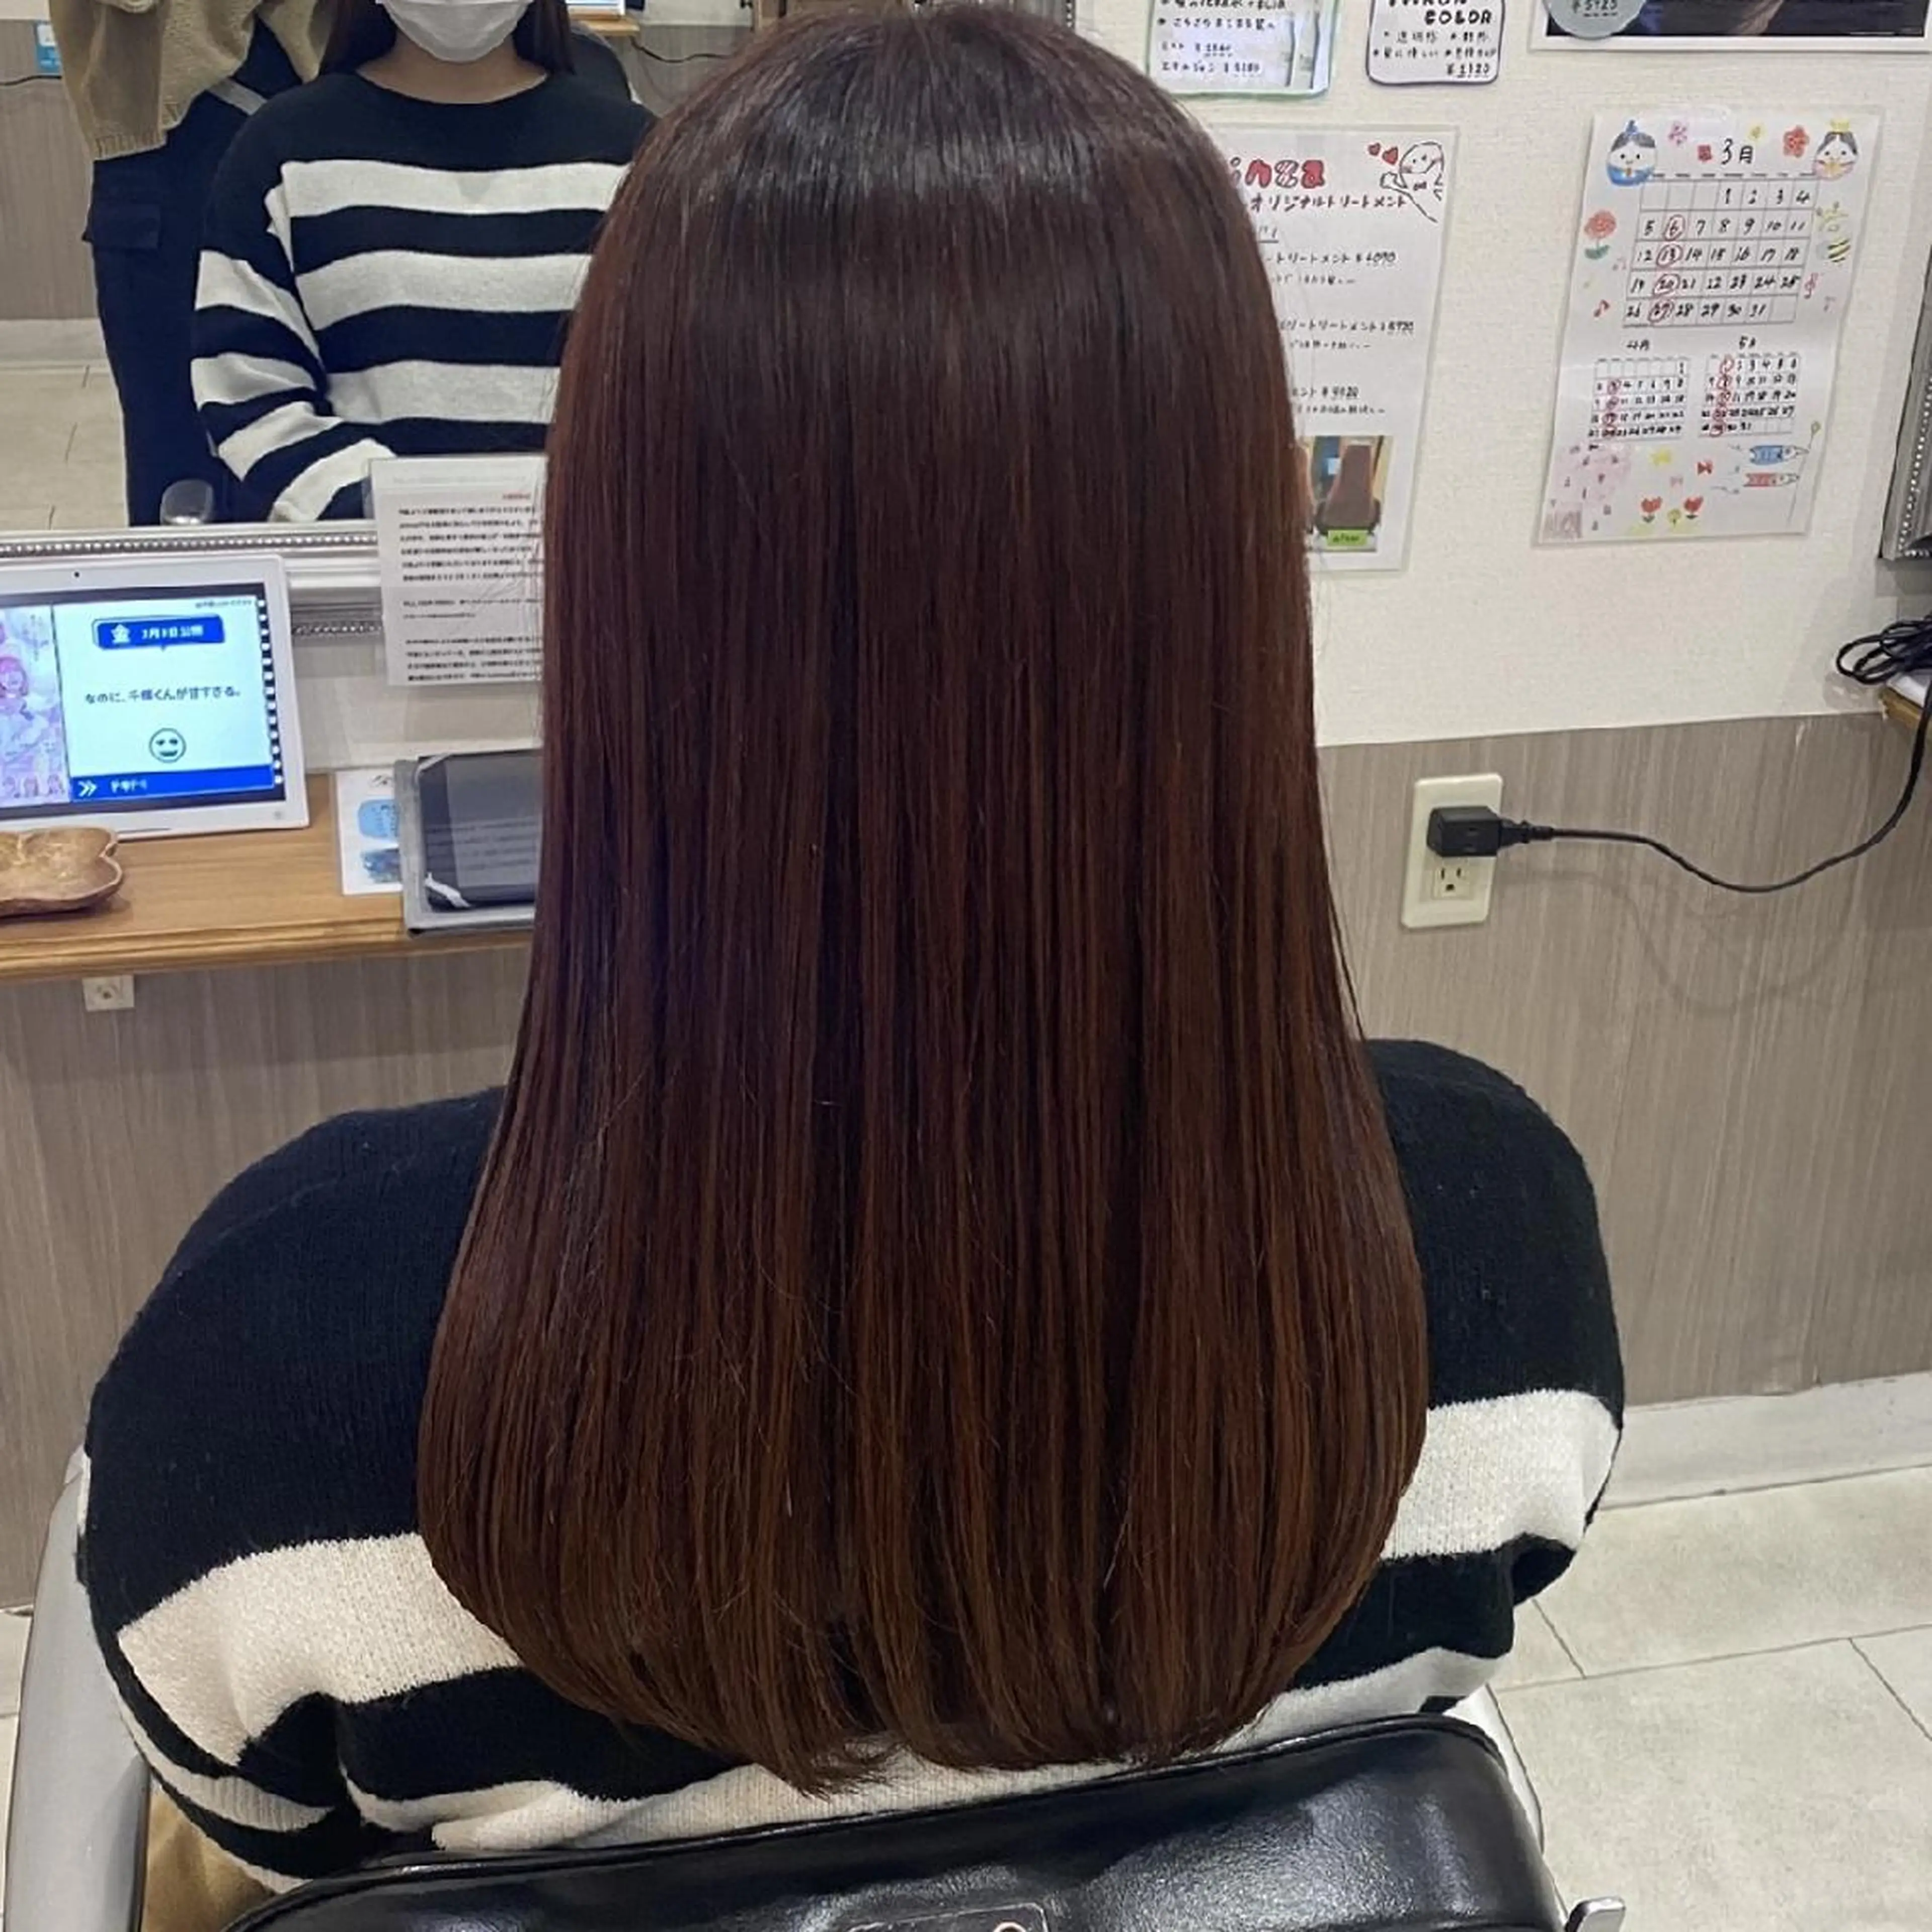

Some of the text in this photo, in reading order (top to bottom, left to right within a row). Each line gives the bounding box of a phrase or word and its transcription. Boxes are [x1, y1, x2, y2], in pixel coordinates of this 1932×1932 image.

[1425, 10, 1491, 25] COLOR
[1721, 138, 1753, 165] 3月
[1251, 193, 1406, 213] オリジナルトリートメント
[1725, 188, 1810, 204] 1 2 3 4
[1644, 218, 1806, 236] 5 6 7 8 9 10 11
[1637, 247, 1800, 262] 12 13 14 15 16 17 18
[1631, 274, 1801, 293] 19 20 21 22 23 24 25
[1627, 302, 1766, 317] 26 27 28 29 30 31
